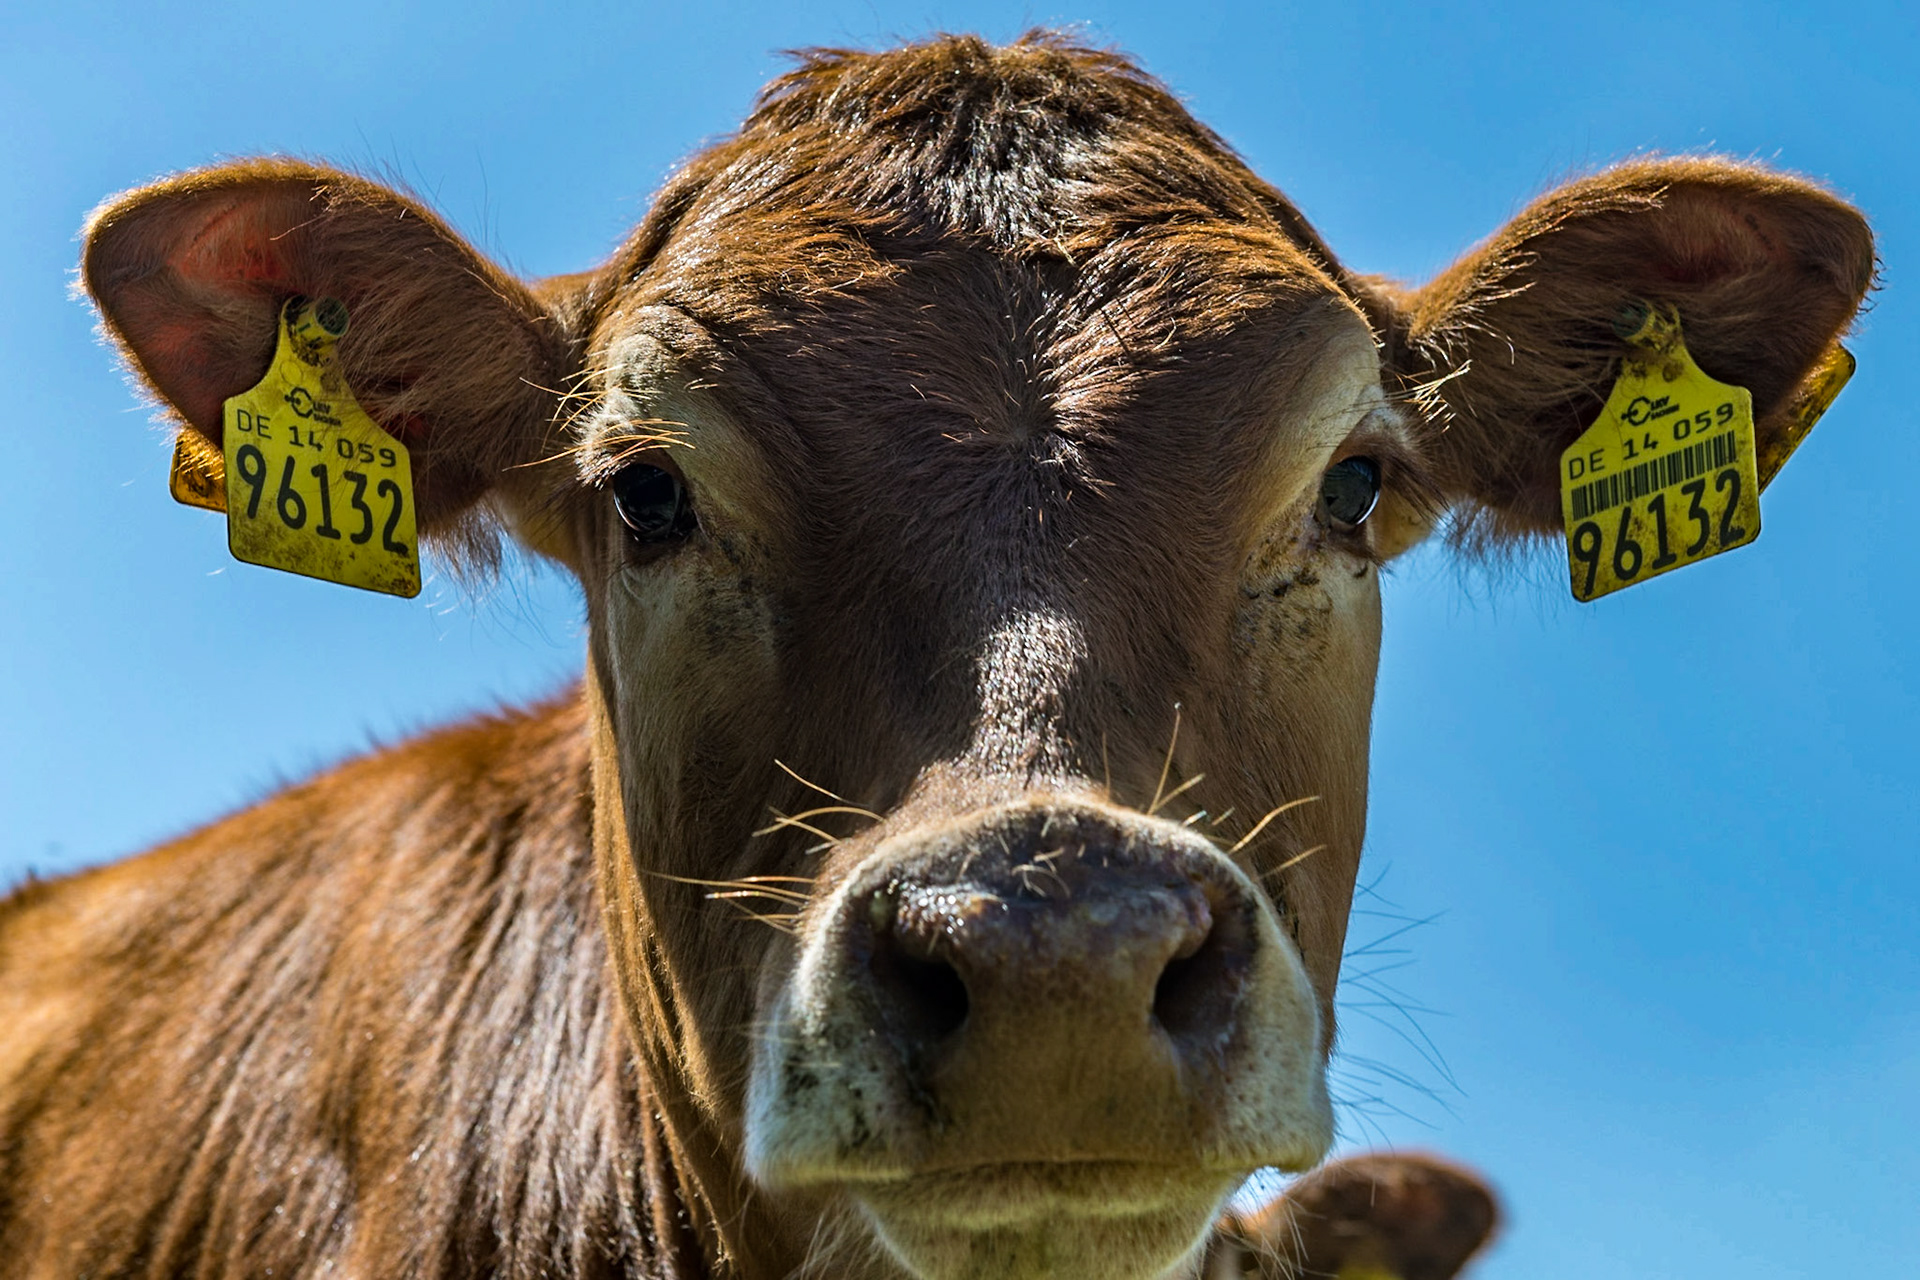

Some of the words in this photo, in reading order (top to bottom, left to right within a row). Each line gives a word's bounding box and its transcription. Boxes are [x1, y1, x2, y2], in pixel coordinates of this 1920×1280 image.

[237, 410, 272, 439] DE
[288, 425, 323, 452] 14
[337, 438, 396, 468] 059
[1569, 448, 1605, 481] DE
[1623, 432, 1659, 460] 14
[1673, 402, 1734, 441] 059
[236, 444, 409, 556] 96132
[1572, 468, 1746, 597] 96132
